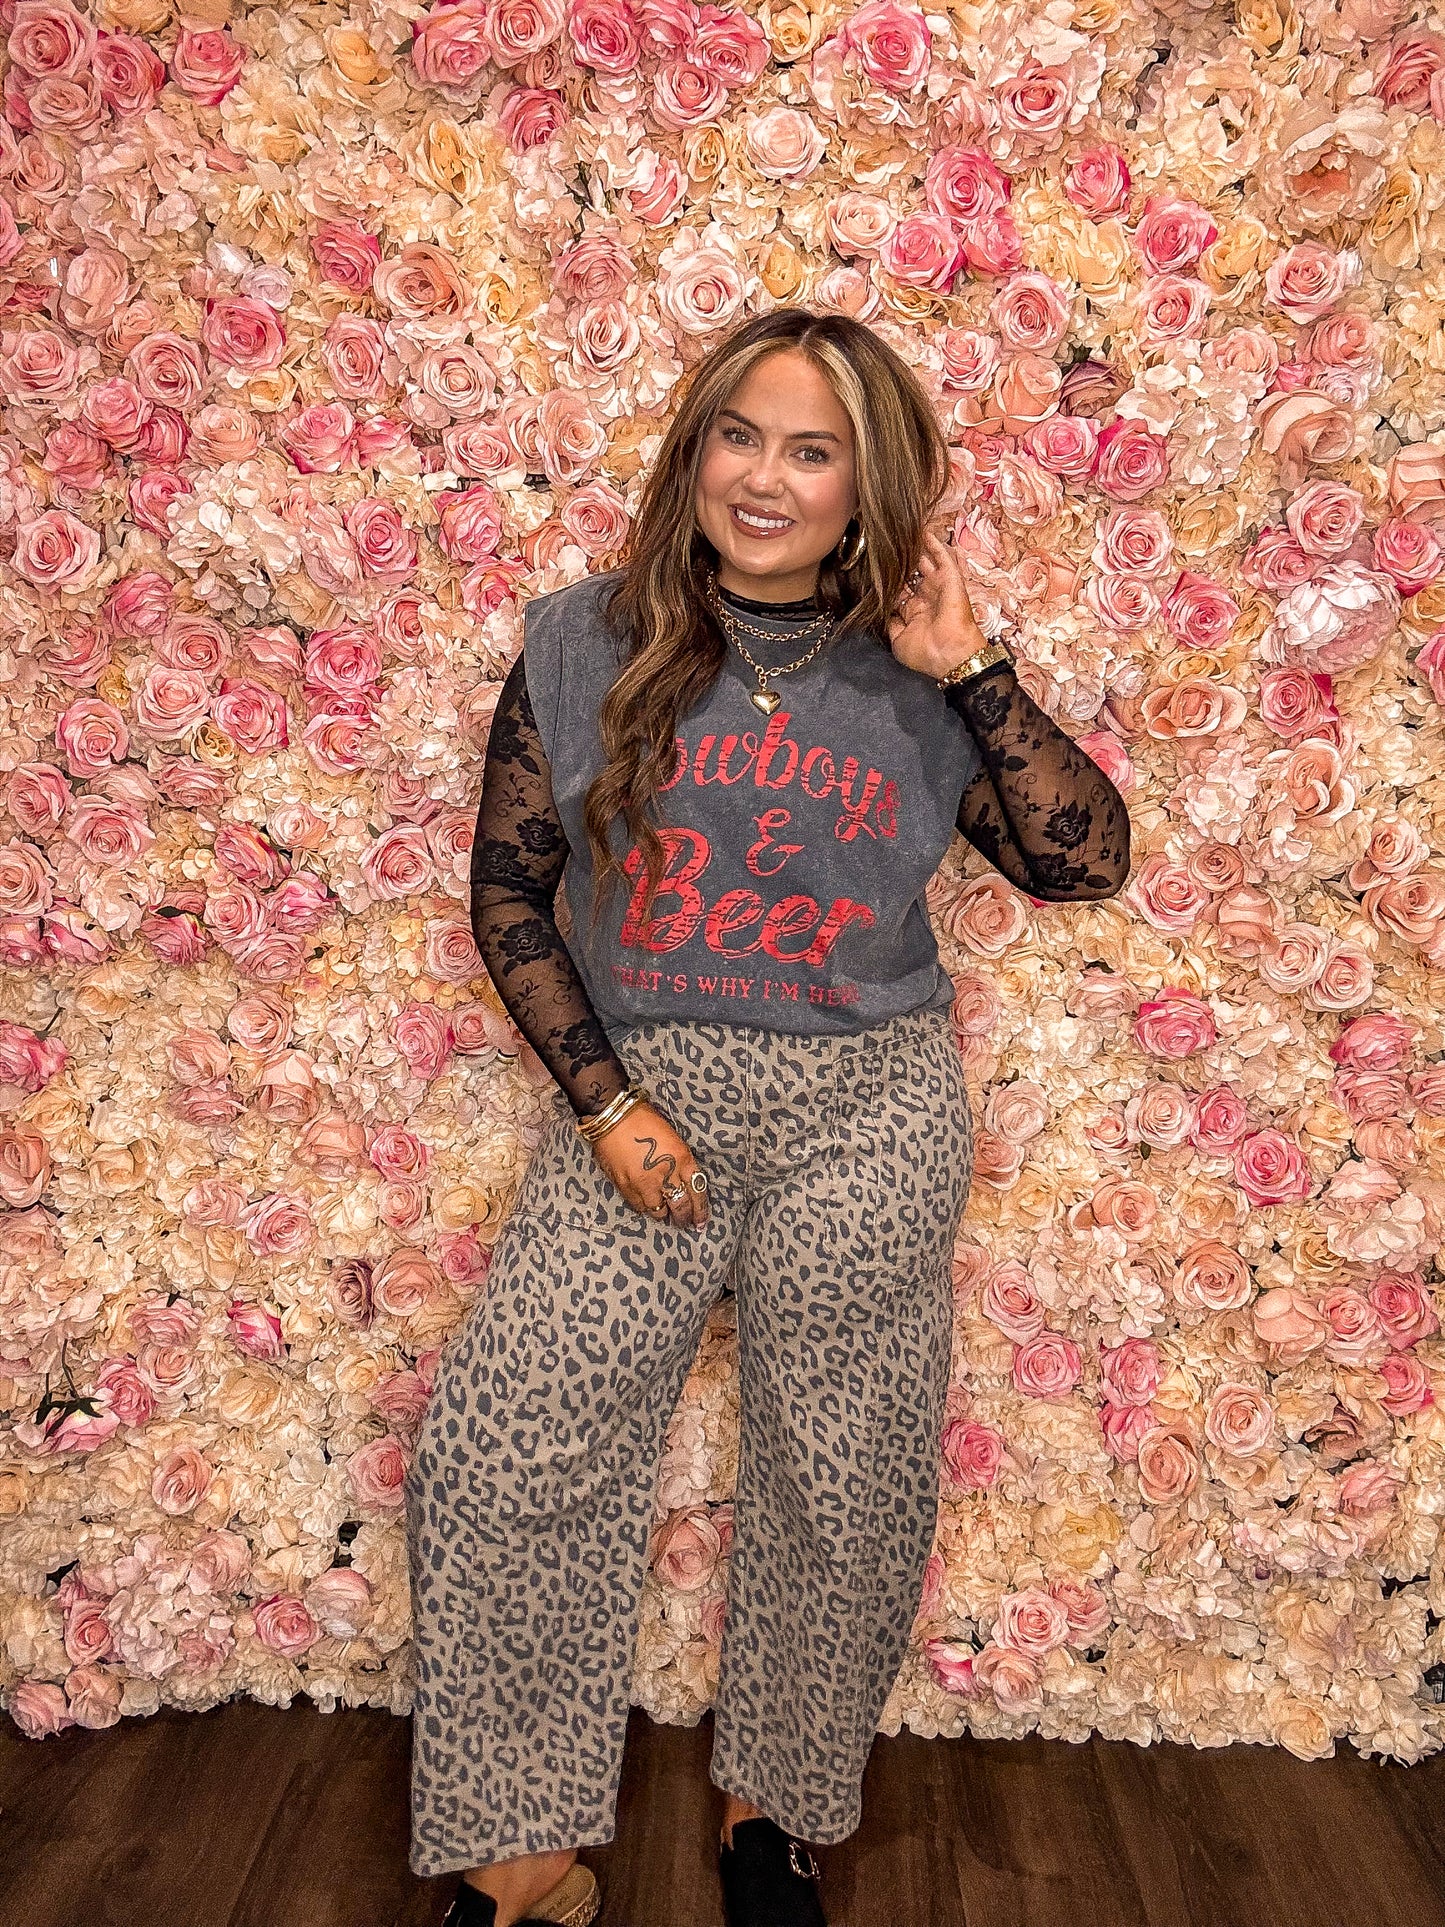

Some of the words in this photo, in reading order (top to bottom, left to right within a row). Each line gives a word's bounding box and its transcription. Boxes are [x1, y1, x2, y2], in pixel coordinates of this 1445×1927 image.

[655, 711, 901, 843] owboys
[745, 808, 805, 877] &
[620, 827, 876, 969] Beer
[610, 964, 688, 993] THAT'S
[697, 975, 755, 999] WHY
[762, 979, 799, 1002] I'M
